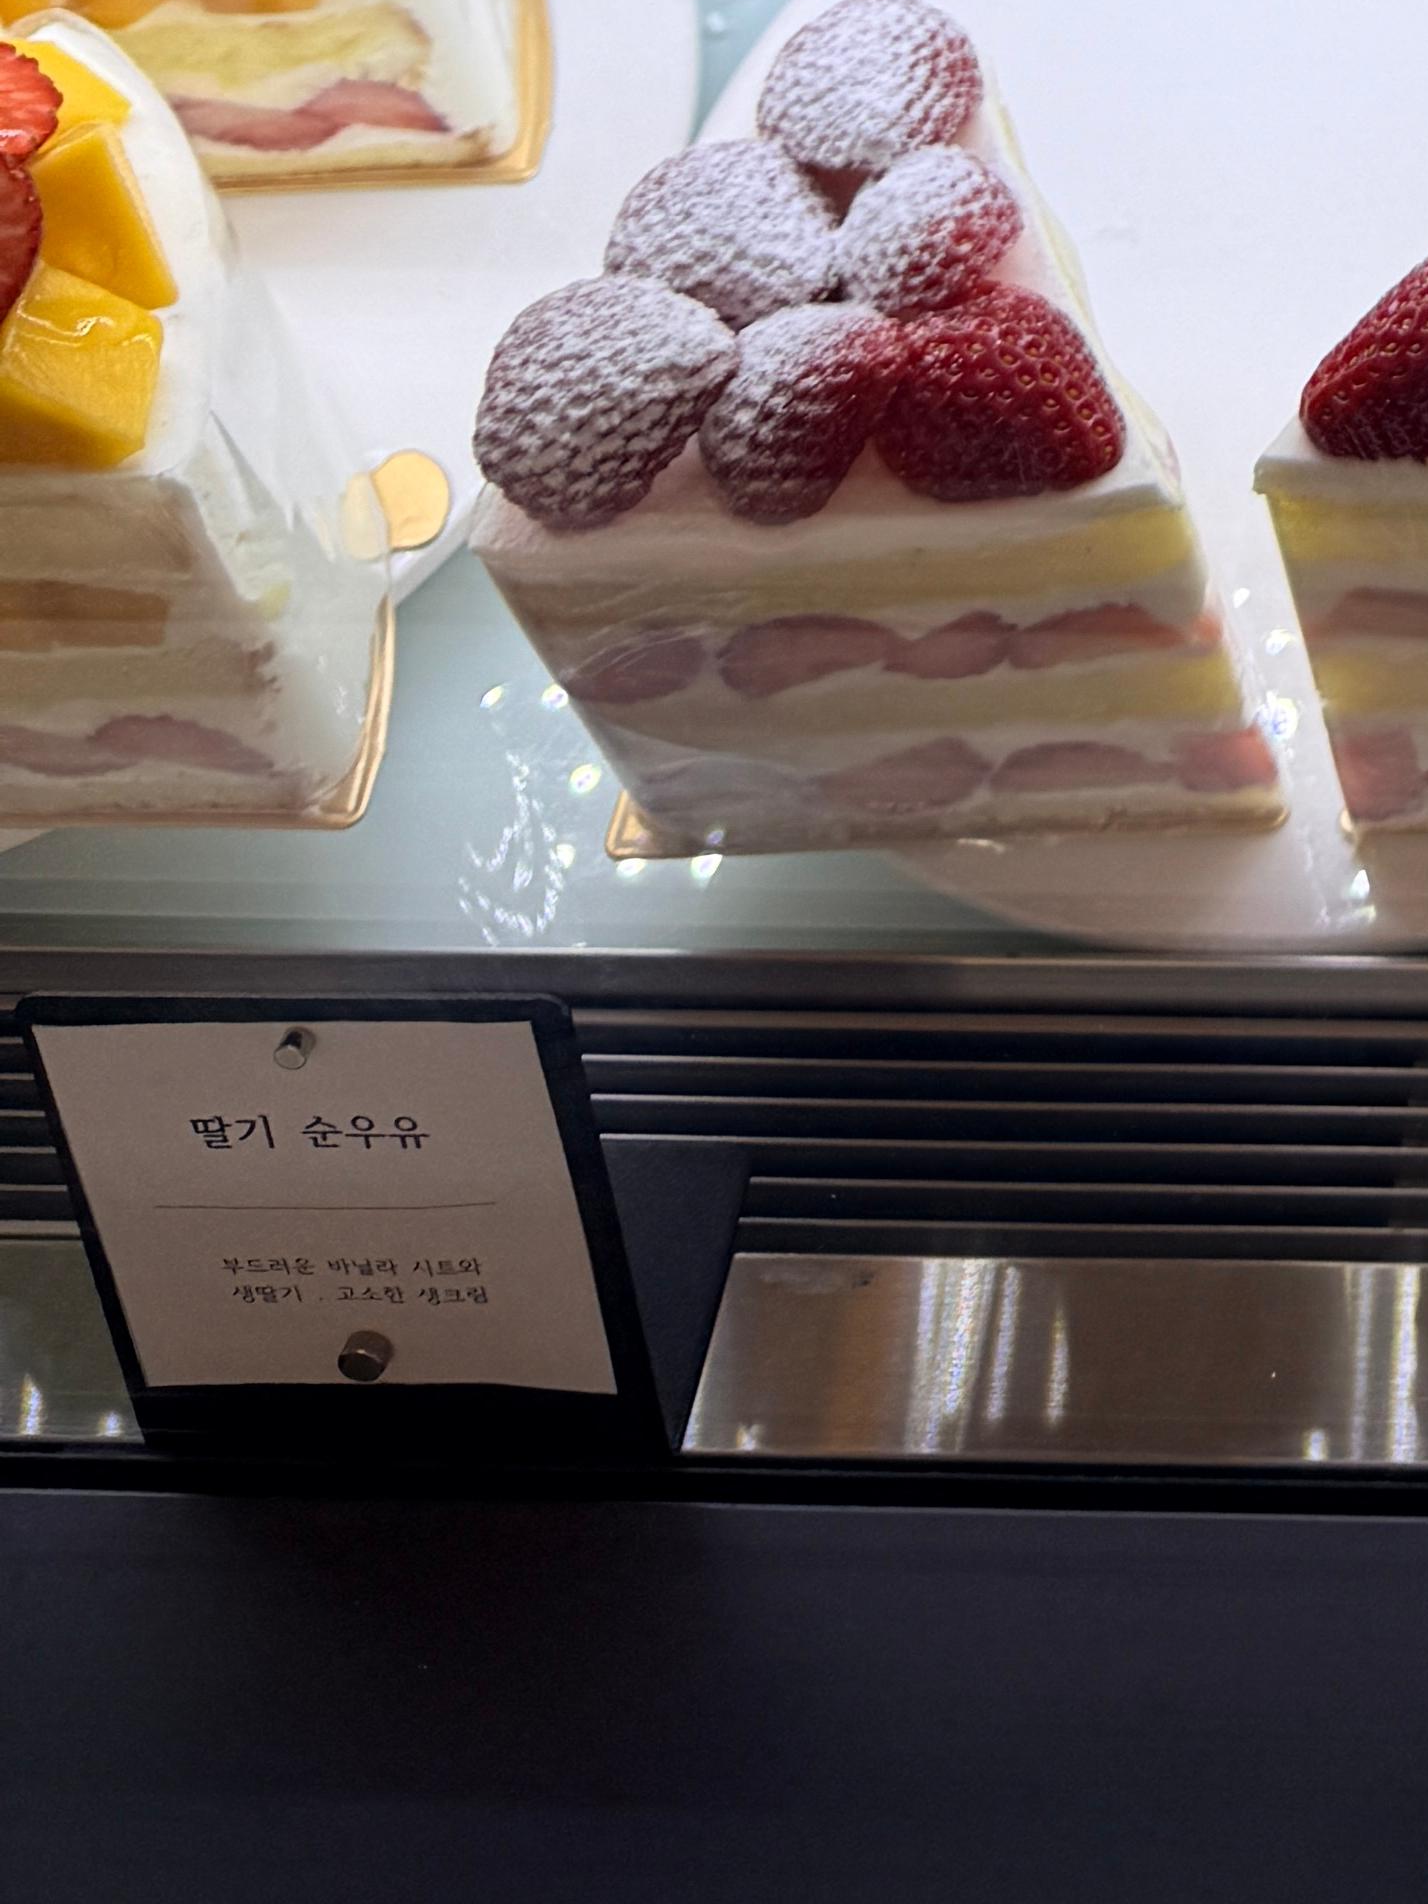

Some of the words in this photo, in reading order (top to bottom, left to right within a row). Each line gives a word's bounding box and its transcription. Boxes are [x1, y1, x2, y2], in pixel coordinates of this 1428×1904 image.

[189, 1114, 275, 1150] 딸기
[301, 1115, 430, 1150] 순우유
[222, 1257, 315, 1276] 부드러운
[327, 1257, 398, 1277] 바닐라
[412, 1257, 481, 1278] 시트와
[337, 1286, 405, 1305] 고소한
[418, 1285, 489, 1306] 생크림
